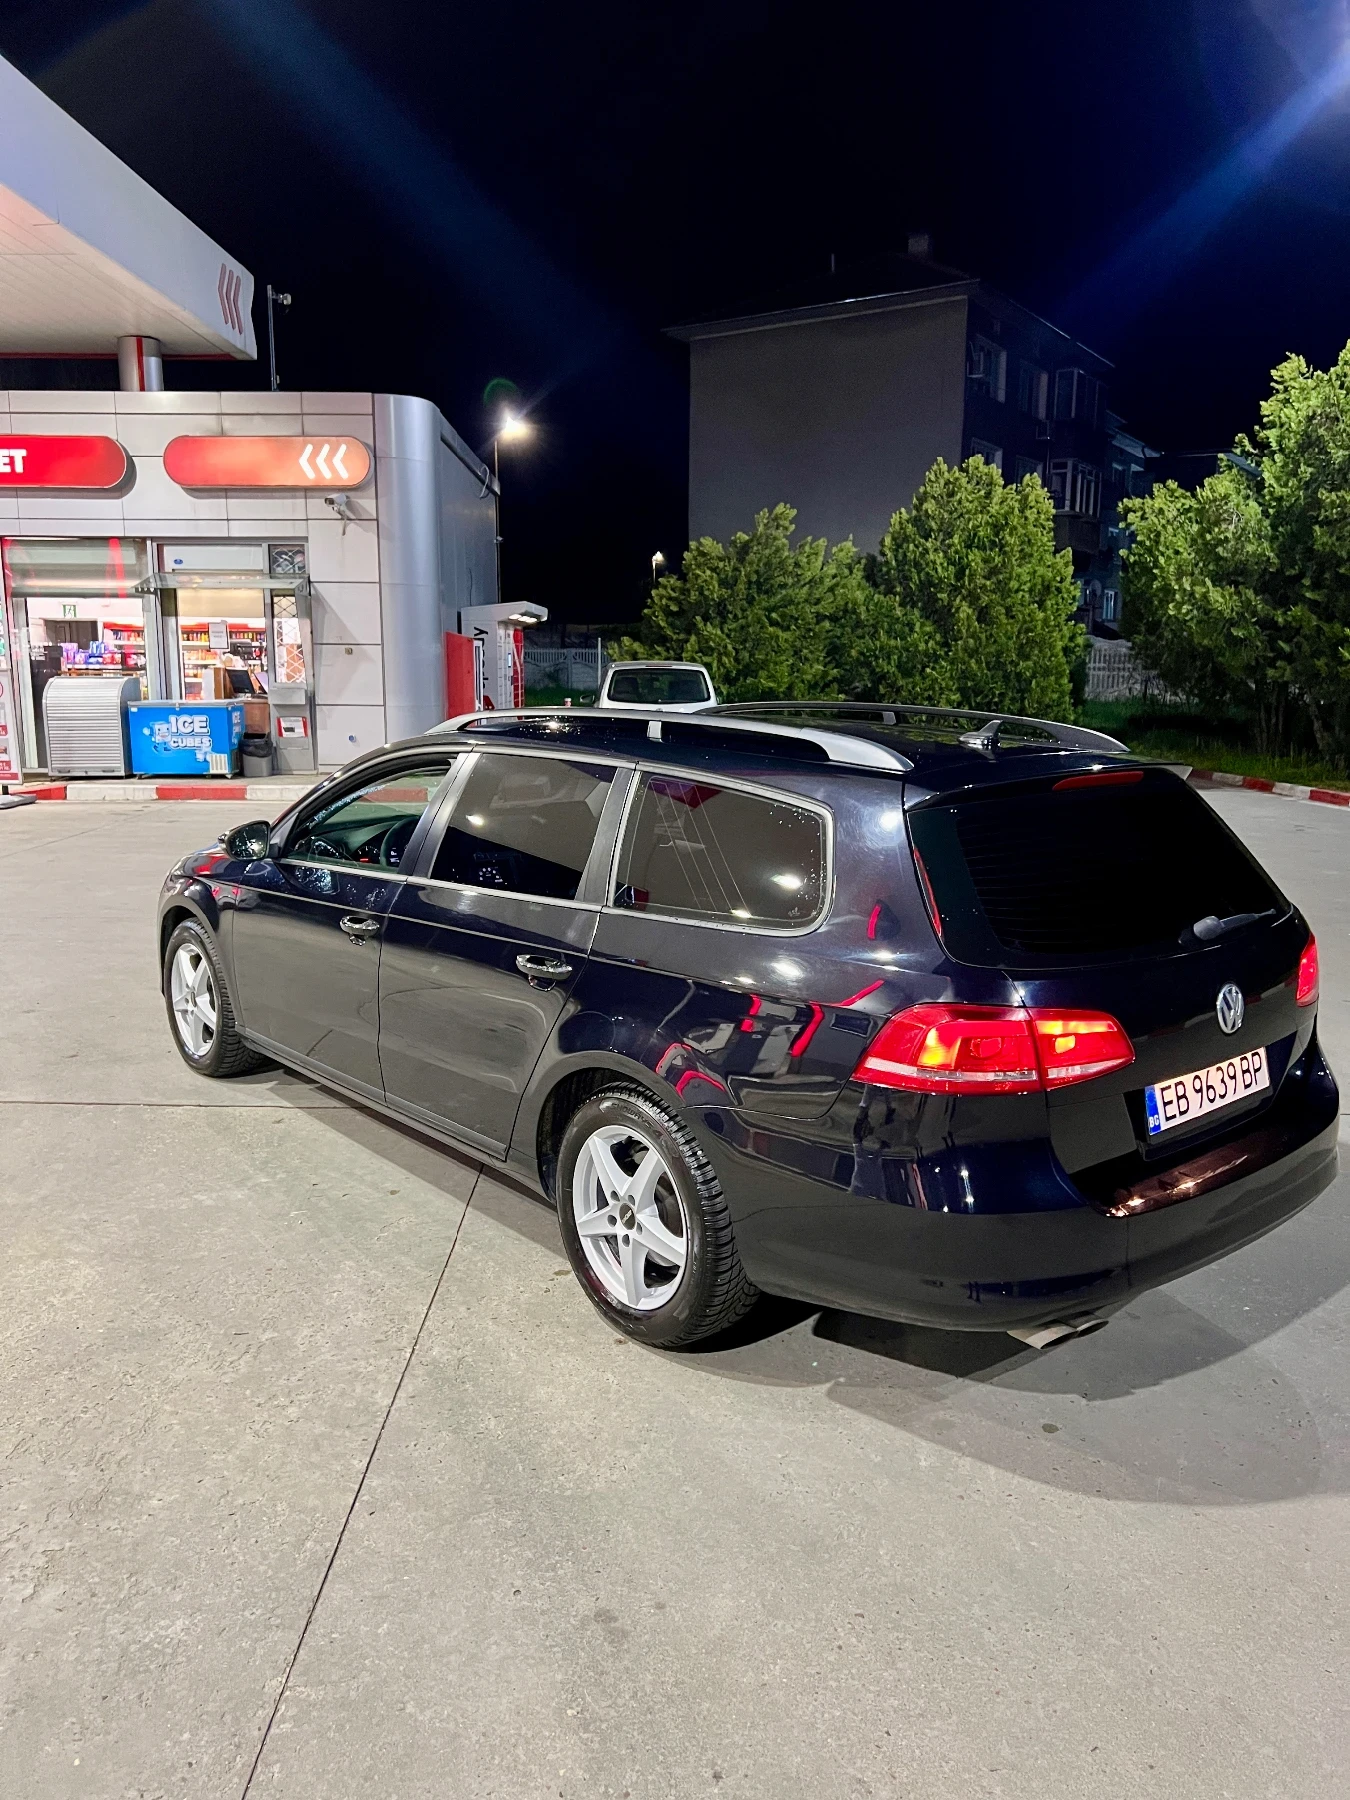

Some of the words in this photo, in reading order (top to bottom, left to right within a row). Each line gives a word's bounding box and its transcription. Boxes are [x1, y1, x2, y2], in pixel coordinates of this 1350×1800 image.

[170, 716, 209, 734] ICE
[171, 737, 211, 748] CUBES
[1160, 1081, 1189, 1122] EB
[1193, 1062, 1237, 1109] 9639
[1240, 1051, 1262, 1090] BP
[1149, 1115, 1160, 1128] BG
